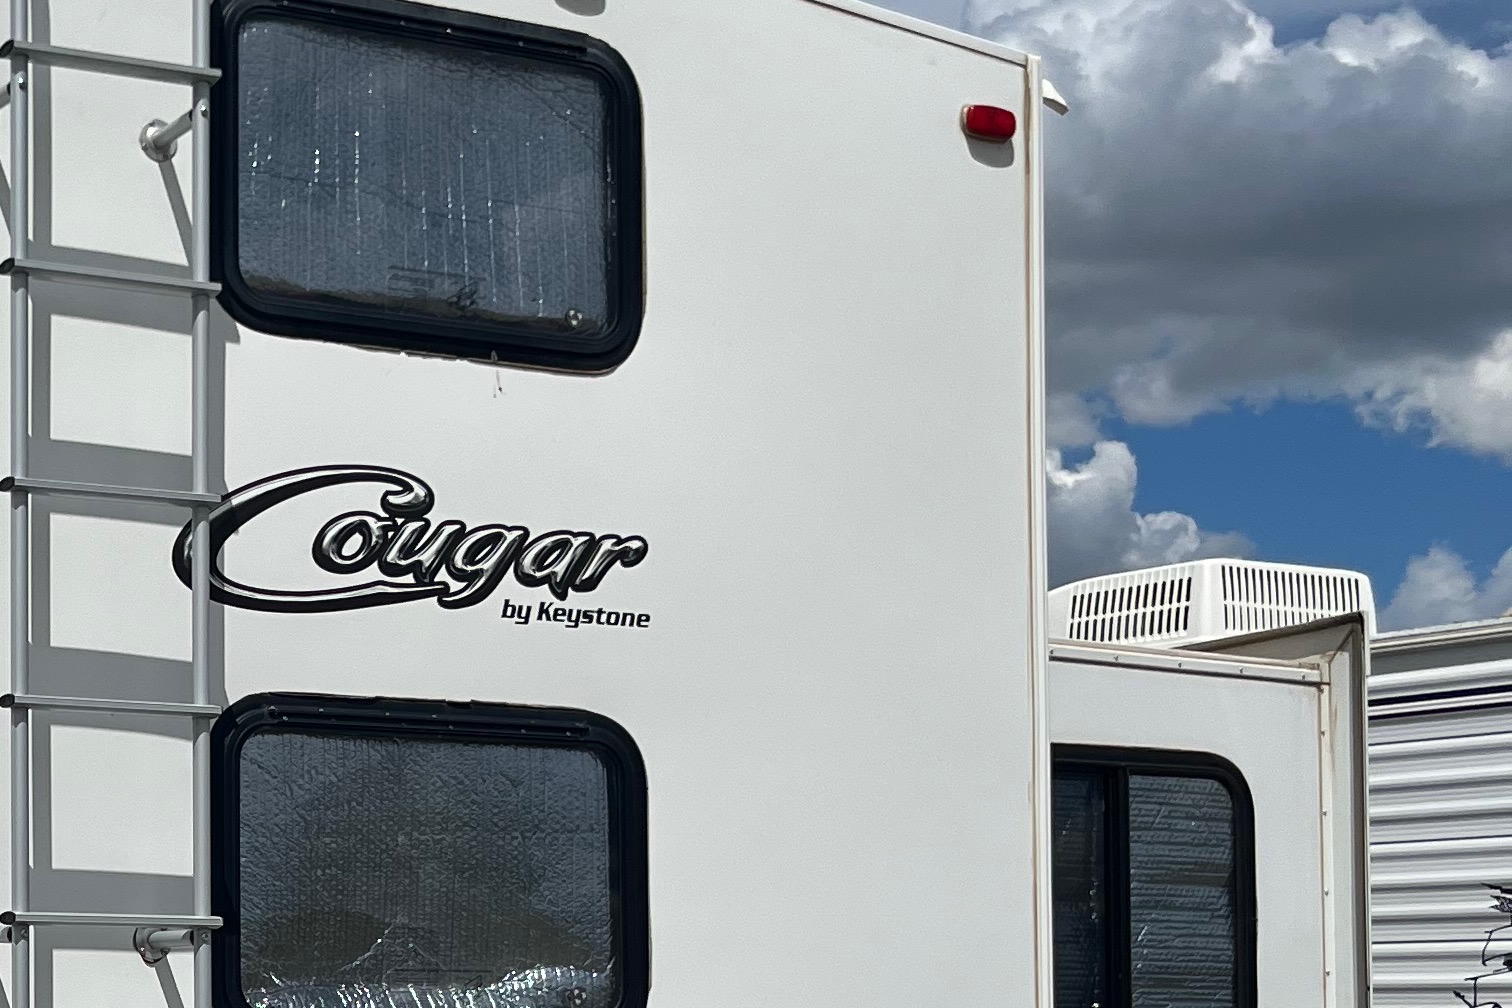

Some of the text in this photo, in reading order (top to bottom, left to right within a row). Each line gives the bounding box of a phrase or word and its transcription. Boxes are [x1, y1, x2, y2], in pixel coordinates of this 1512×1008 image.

[172, 464, 649, 613] Cougar
[501, 599, 651, 628] by Keystone
